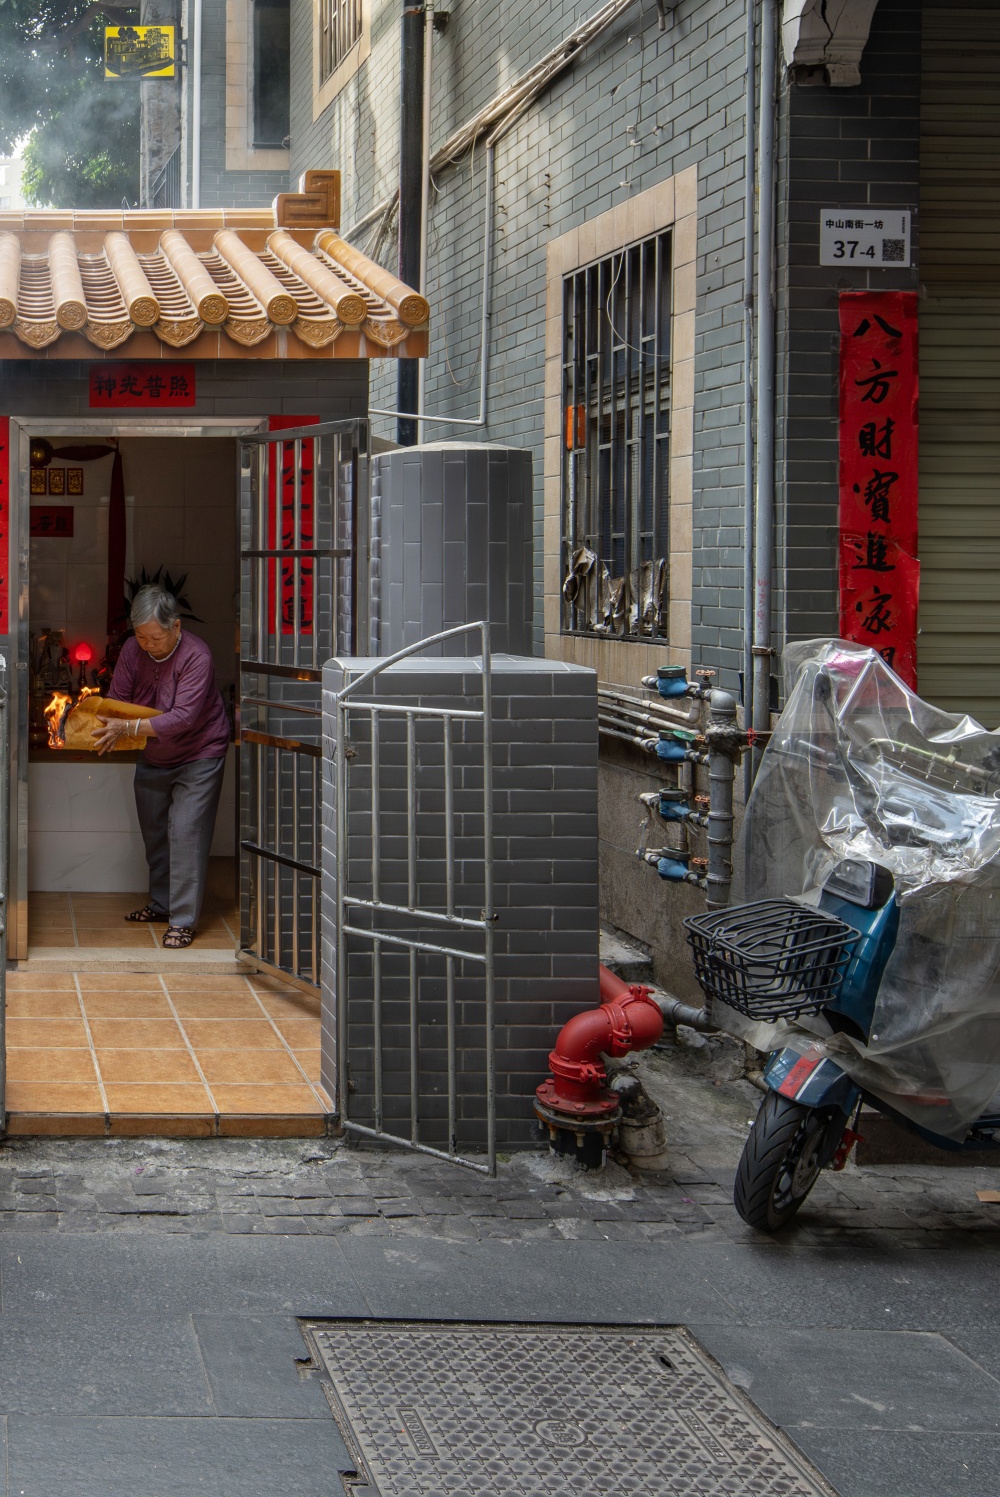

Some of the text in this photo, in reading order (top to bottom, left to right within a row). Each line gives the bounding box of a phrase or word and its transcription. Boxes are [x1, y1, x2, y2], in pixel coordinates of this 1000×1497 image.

[825, 218, 884, 230] 中山南街一坊
[833, 240, 876, 259] 37-4
[94, 374, 190, 399] 神光普照
